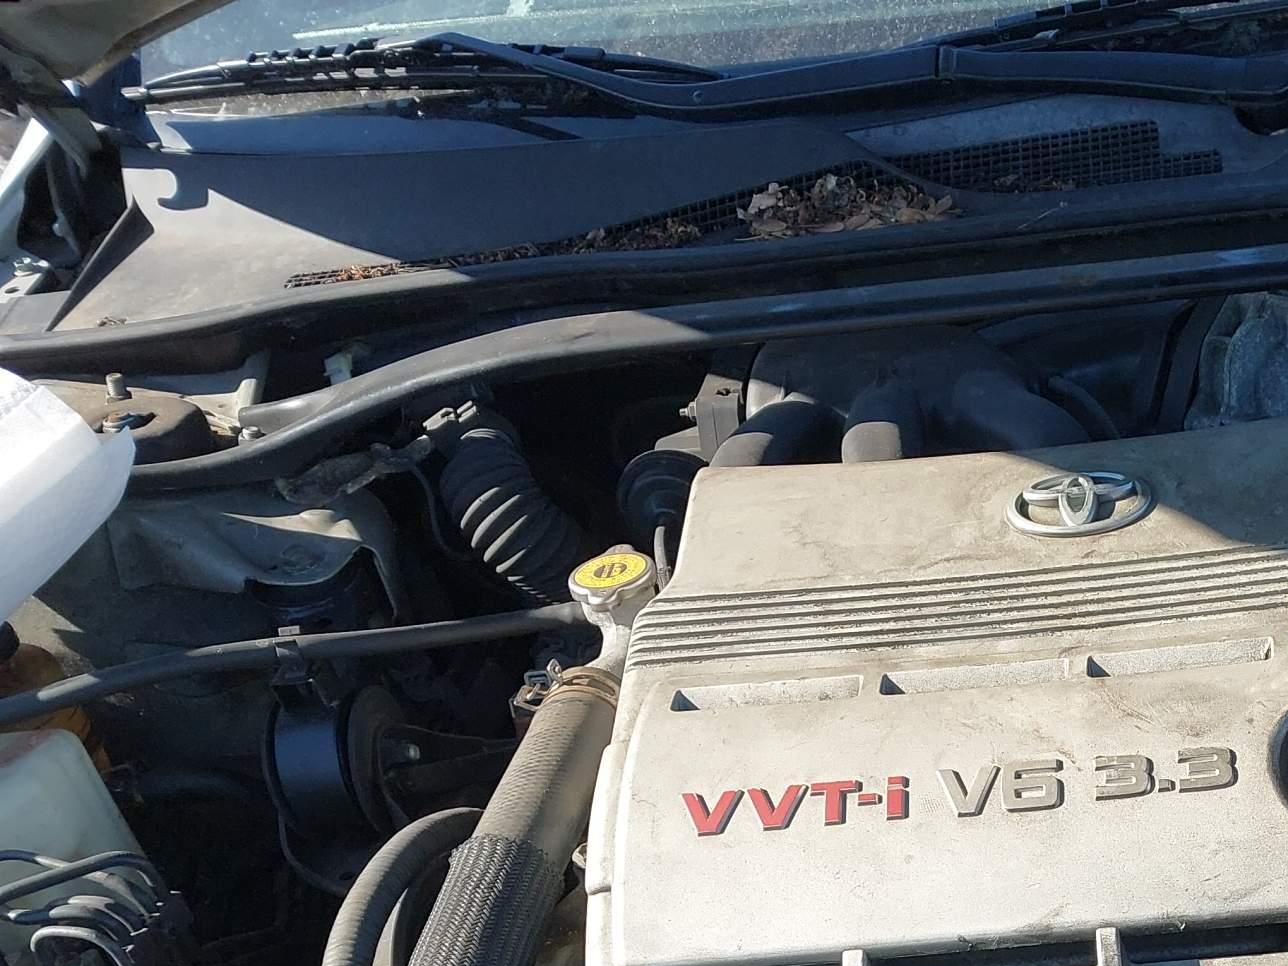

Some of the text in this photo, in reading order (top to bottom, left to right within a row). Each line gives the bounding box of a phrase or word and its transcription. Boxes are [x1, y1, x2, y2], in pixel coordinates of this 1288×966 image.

[681, 747, 1237, 837] VVT-i V6 3.3
